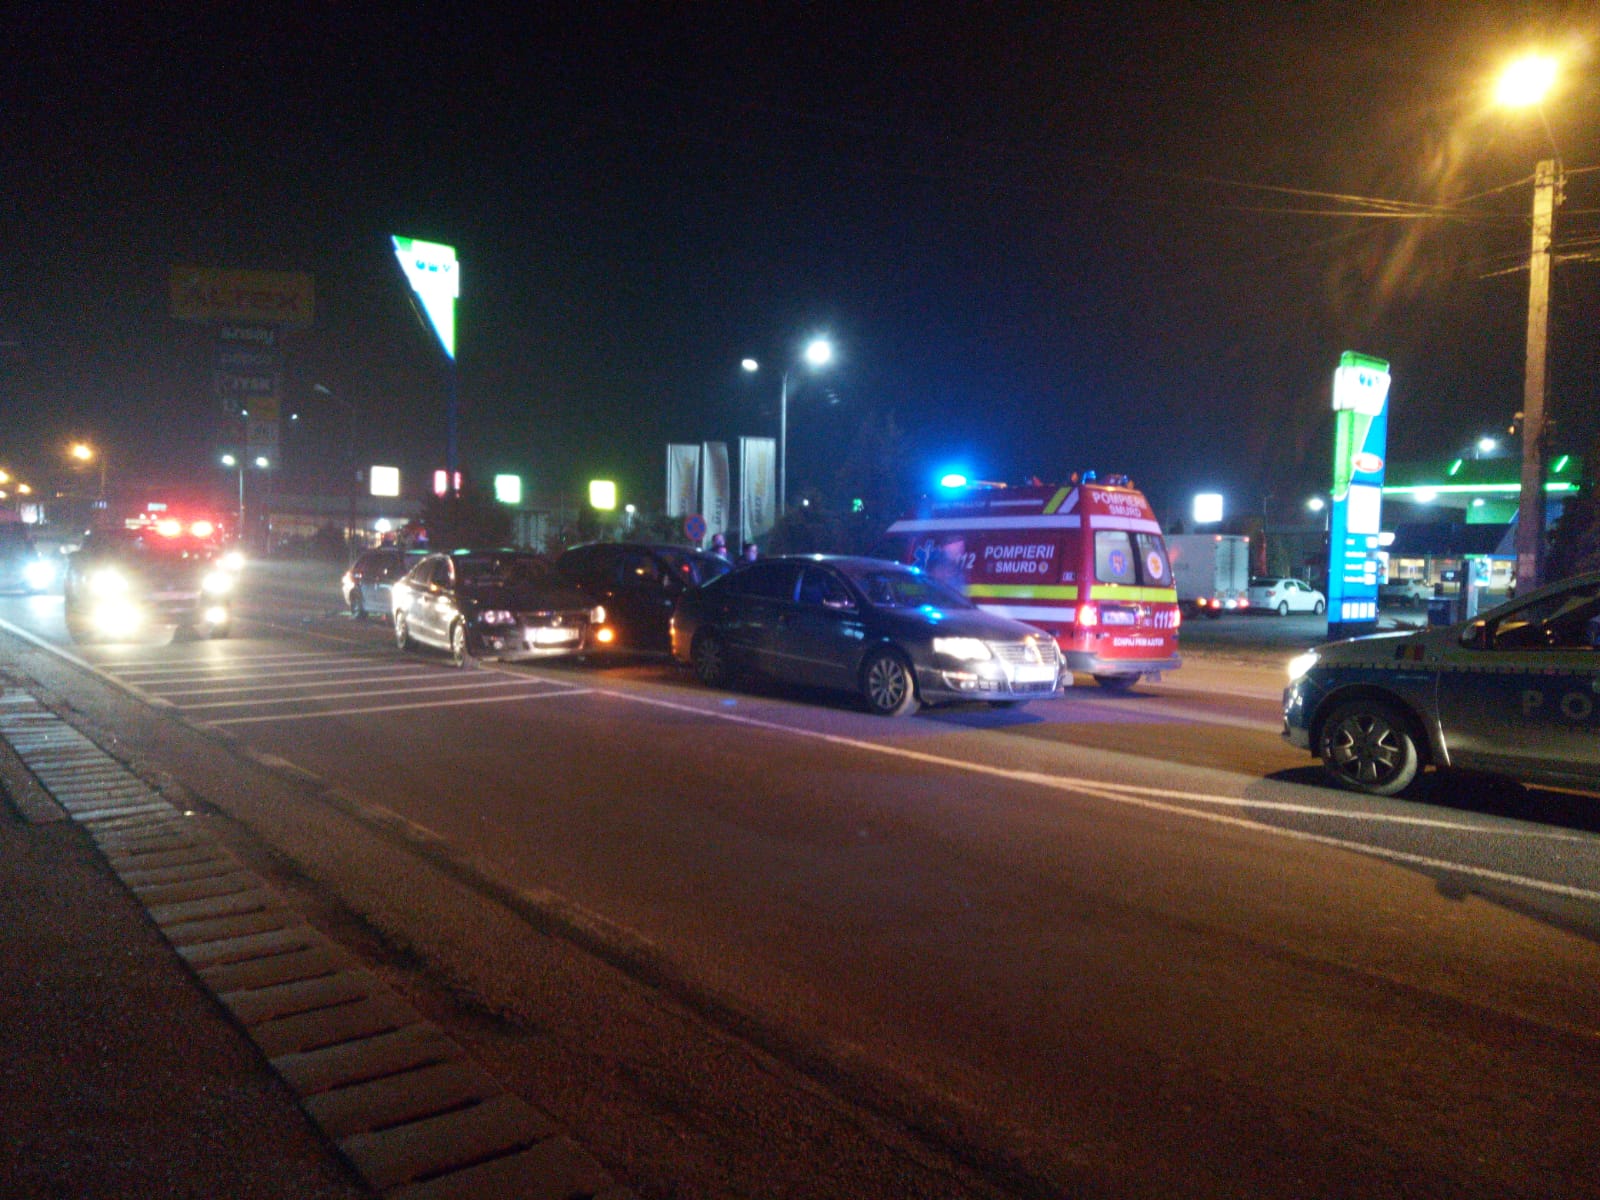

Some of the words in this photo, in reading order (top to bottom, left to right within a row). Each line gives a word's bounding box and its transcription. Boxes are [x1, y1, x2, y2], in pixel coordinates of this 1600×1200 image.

[1108, 504, 1142, 518] SMURD
[984, 545, 1055, 560] POMPIERII
[995, 561, 1037, 574] SMURD
